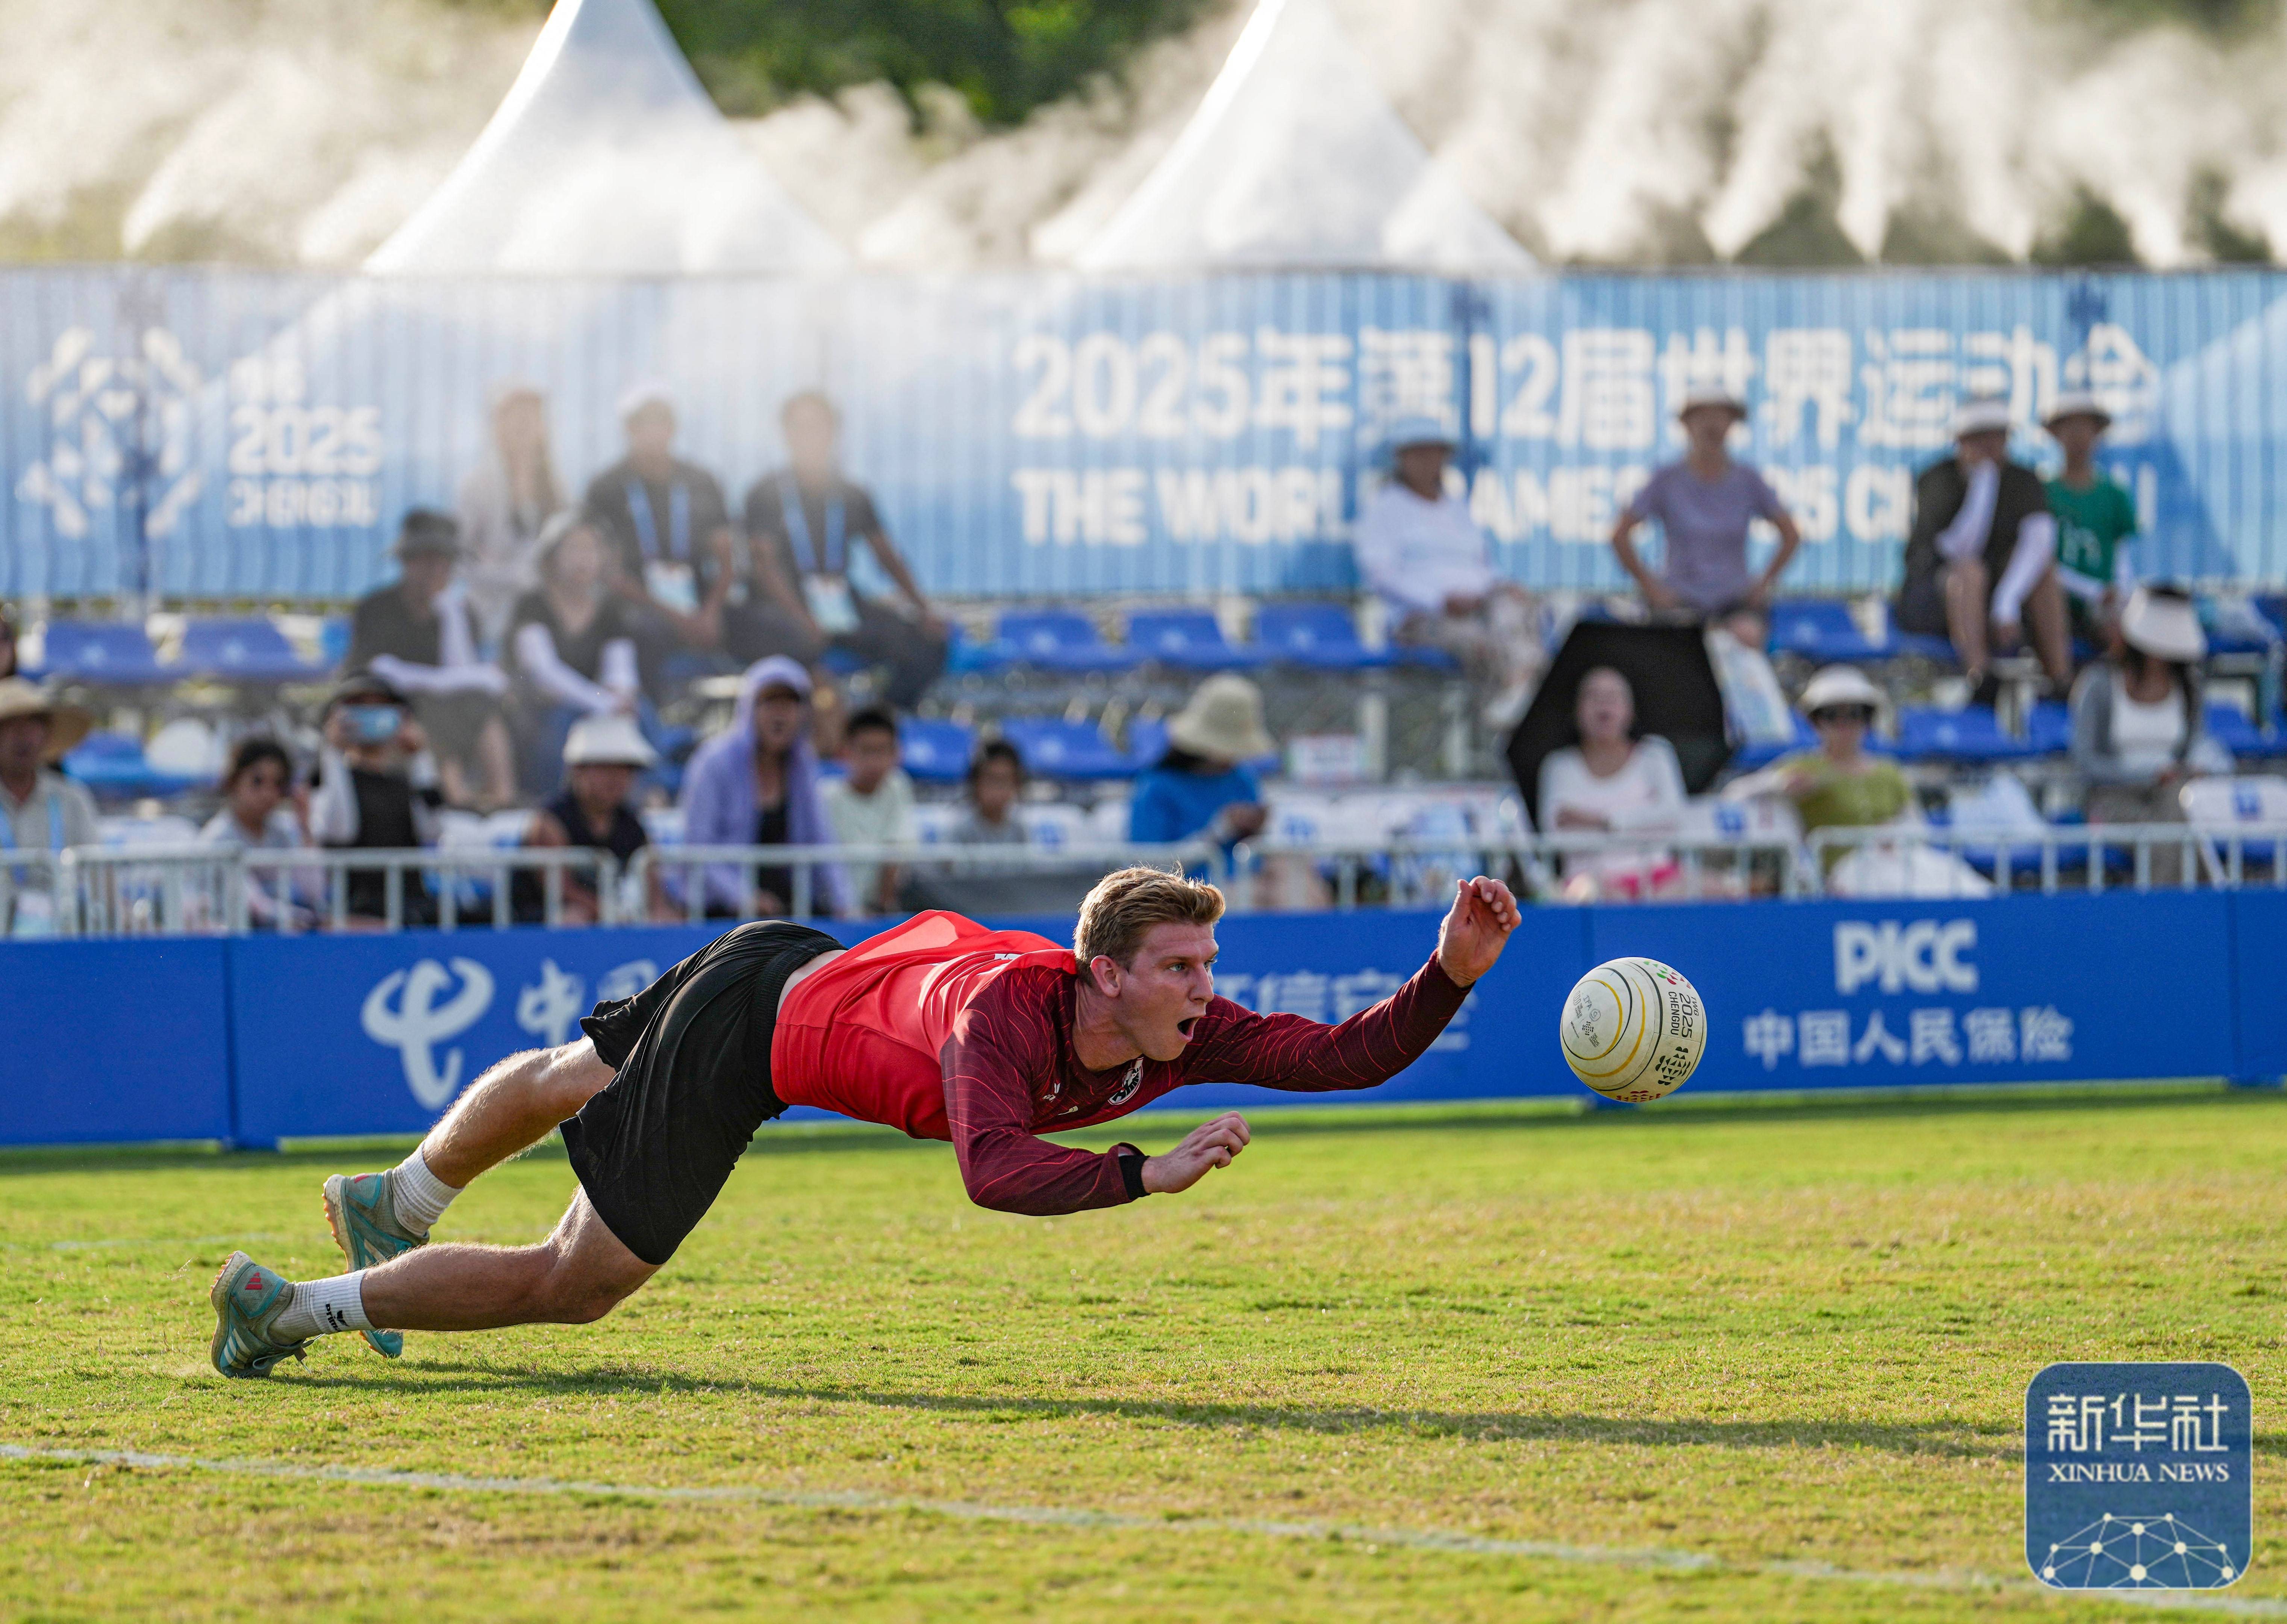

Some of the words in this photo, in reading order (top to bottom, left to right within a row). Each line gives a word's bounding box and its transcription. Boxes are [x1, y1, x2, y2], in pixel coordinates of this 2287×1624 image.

[229, 405, 382, 475] 2025
[1011, 466, 1148, 547] THE
[1155, 466, 1387, 546] WORL
[1834, 920, 1978, 995] PICC
[1668, 991, 1680, 1035] CHENGDU
[1679, 993, 1693, 1038] 2025
[1691, 996, 1699, 1016] TWG
[1591, 1035, 1600, 1046] 2025
[1743, 1005, 2075, 1070] 中国人民保险
